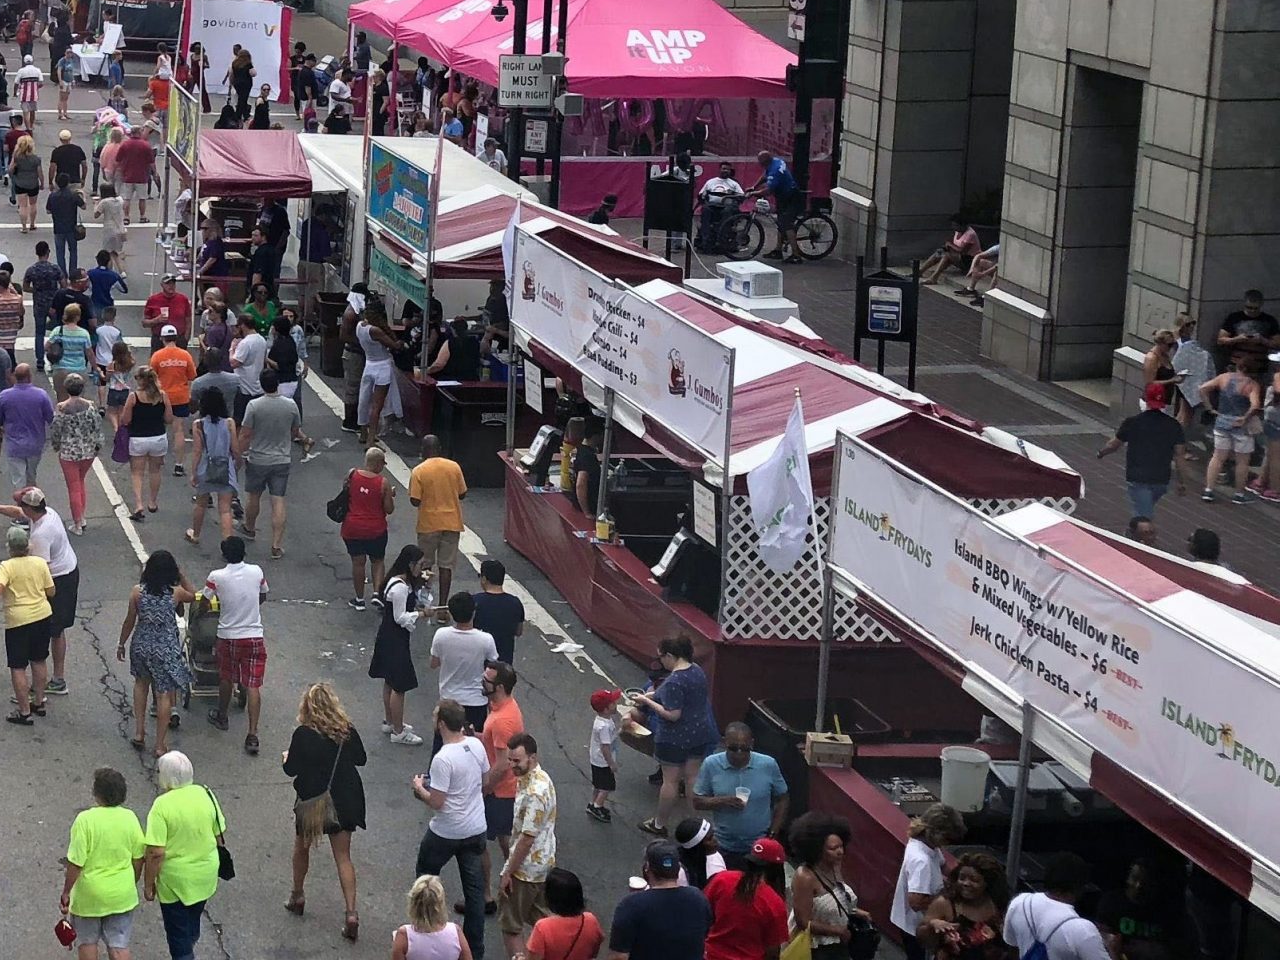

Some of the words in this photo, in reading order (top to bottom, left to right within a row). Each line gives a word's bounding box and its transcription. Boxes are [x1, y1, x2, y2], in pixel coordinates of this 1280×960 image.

[202, 17, 258, 31] govibrant
[626, 29, 706, 48] AMP
[648, 47, 694, 66] UP
[502, 62, 525, 71] RIGHT
[528, 62, 543, 71] LAN
[512, 76, 539, 86] MUST
[501, 91, 523, 99] TURN
[525, 91, 549, 100] RIGHT
[637, 313, 646, 329] $4
[629, 330, 639, 345] $4
[619, 344, 627, 360] $4
[597, 354, 624, 381] Pudding
[629, 370, 638, 385] $3
[844, 496, 880, 532] ISLAND
[887, 526, 933, 568] FRYDAYS
[954, 538, 983, 572] Island
[985, 562, 1010, 588] BBQ
[1012, 573, 1043, 610] Wings
[1046, 598, 1108, 647] w/Yellow
[1111, 632, 1140, 665] Rice
[971, 576, 980, 594] &
[981, 583, 1014, 619] Mixed
[1016, 604, 1078, 658] Vegetables
[1092, 654, 1108, 675] $6
[970, 616, 992, 645] Jerk
[994, 631, 1034, 672] Chicken
[1037, 658, 1070, 695] Pasta
[1083, 690, 1098, 714] $4
[1161, 696, 1218, 747] ISLAND
